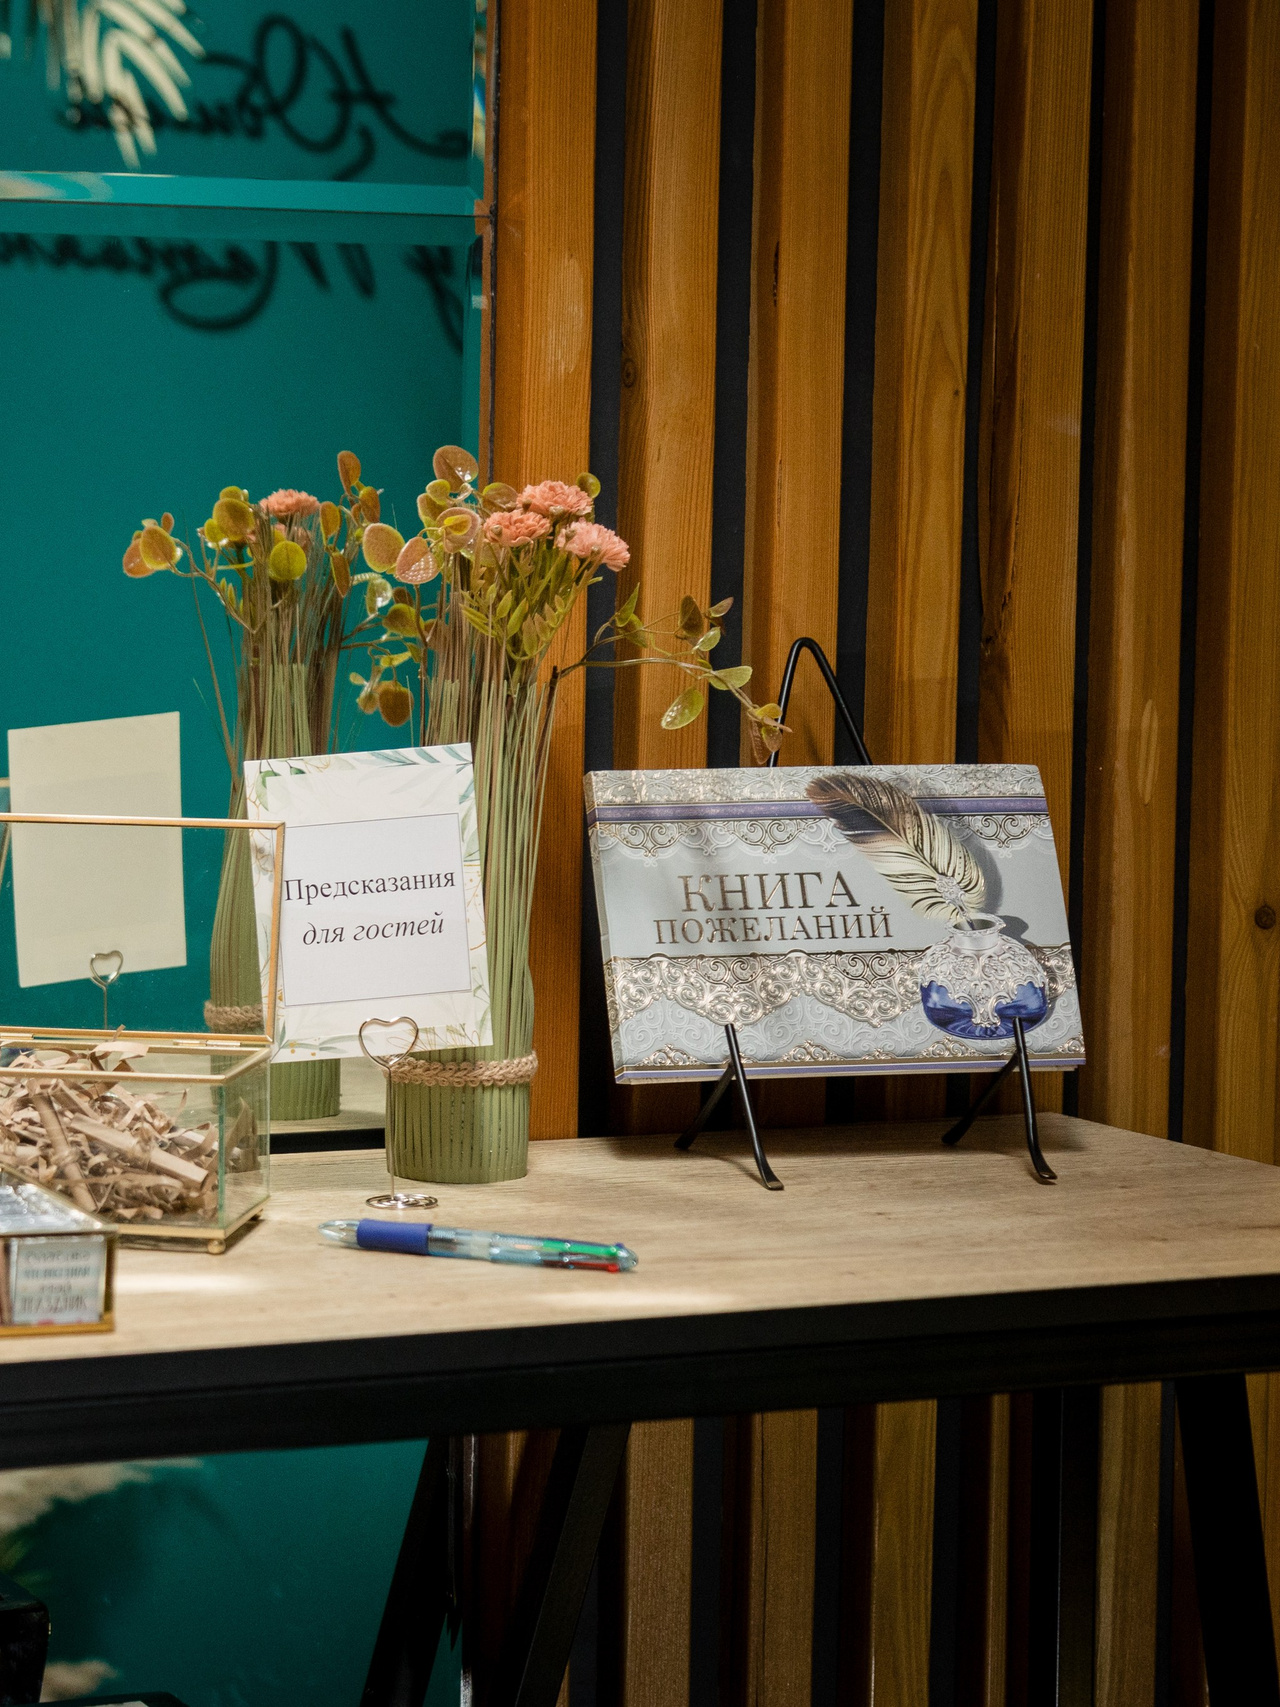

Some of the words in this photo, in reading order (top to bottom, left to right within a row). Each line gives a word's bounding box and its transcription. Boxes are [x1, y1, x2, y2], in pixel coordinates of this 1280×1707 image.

[284, 871, 457, 906] Предсказания
[677, 869, 862, 913] КНИГА
[302, 922, 346, 945] для
[353, 911, 445, 942] гостей
[653, 906, 894, 945] ПОЖЕЛАНИЙ
